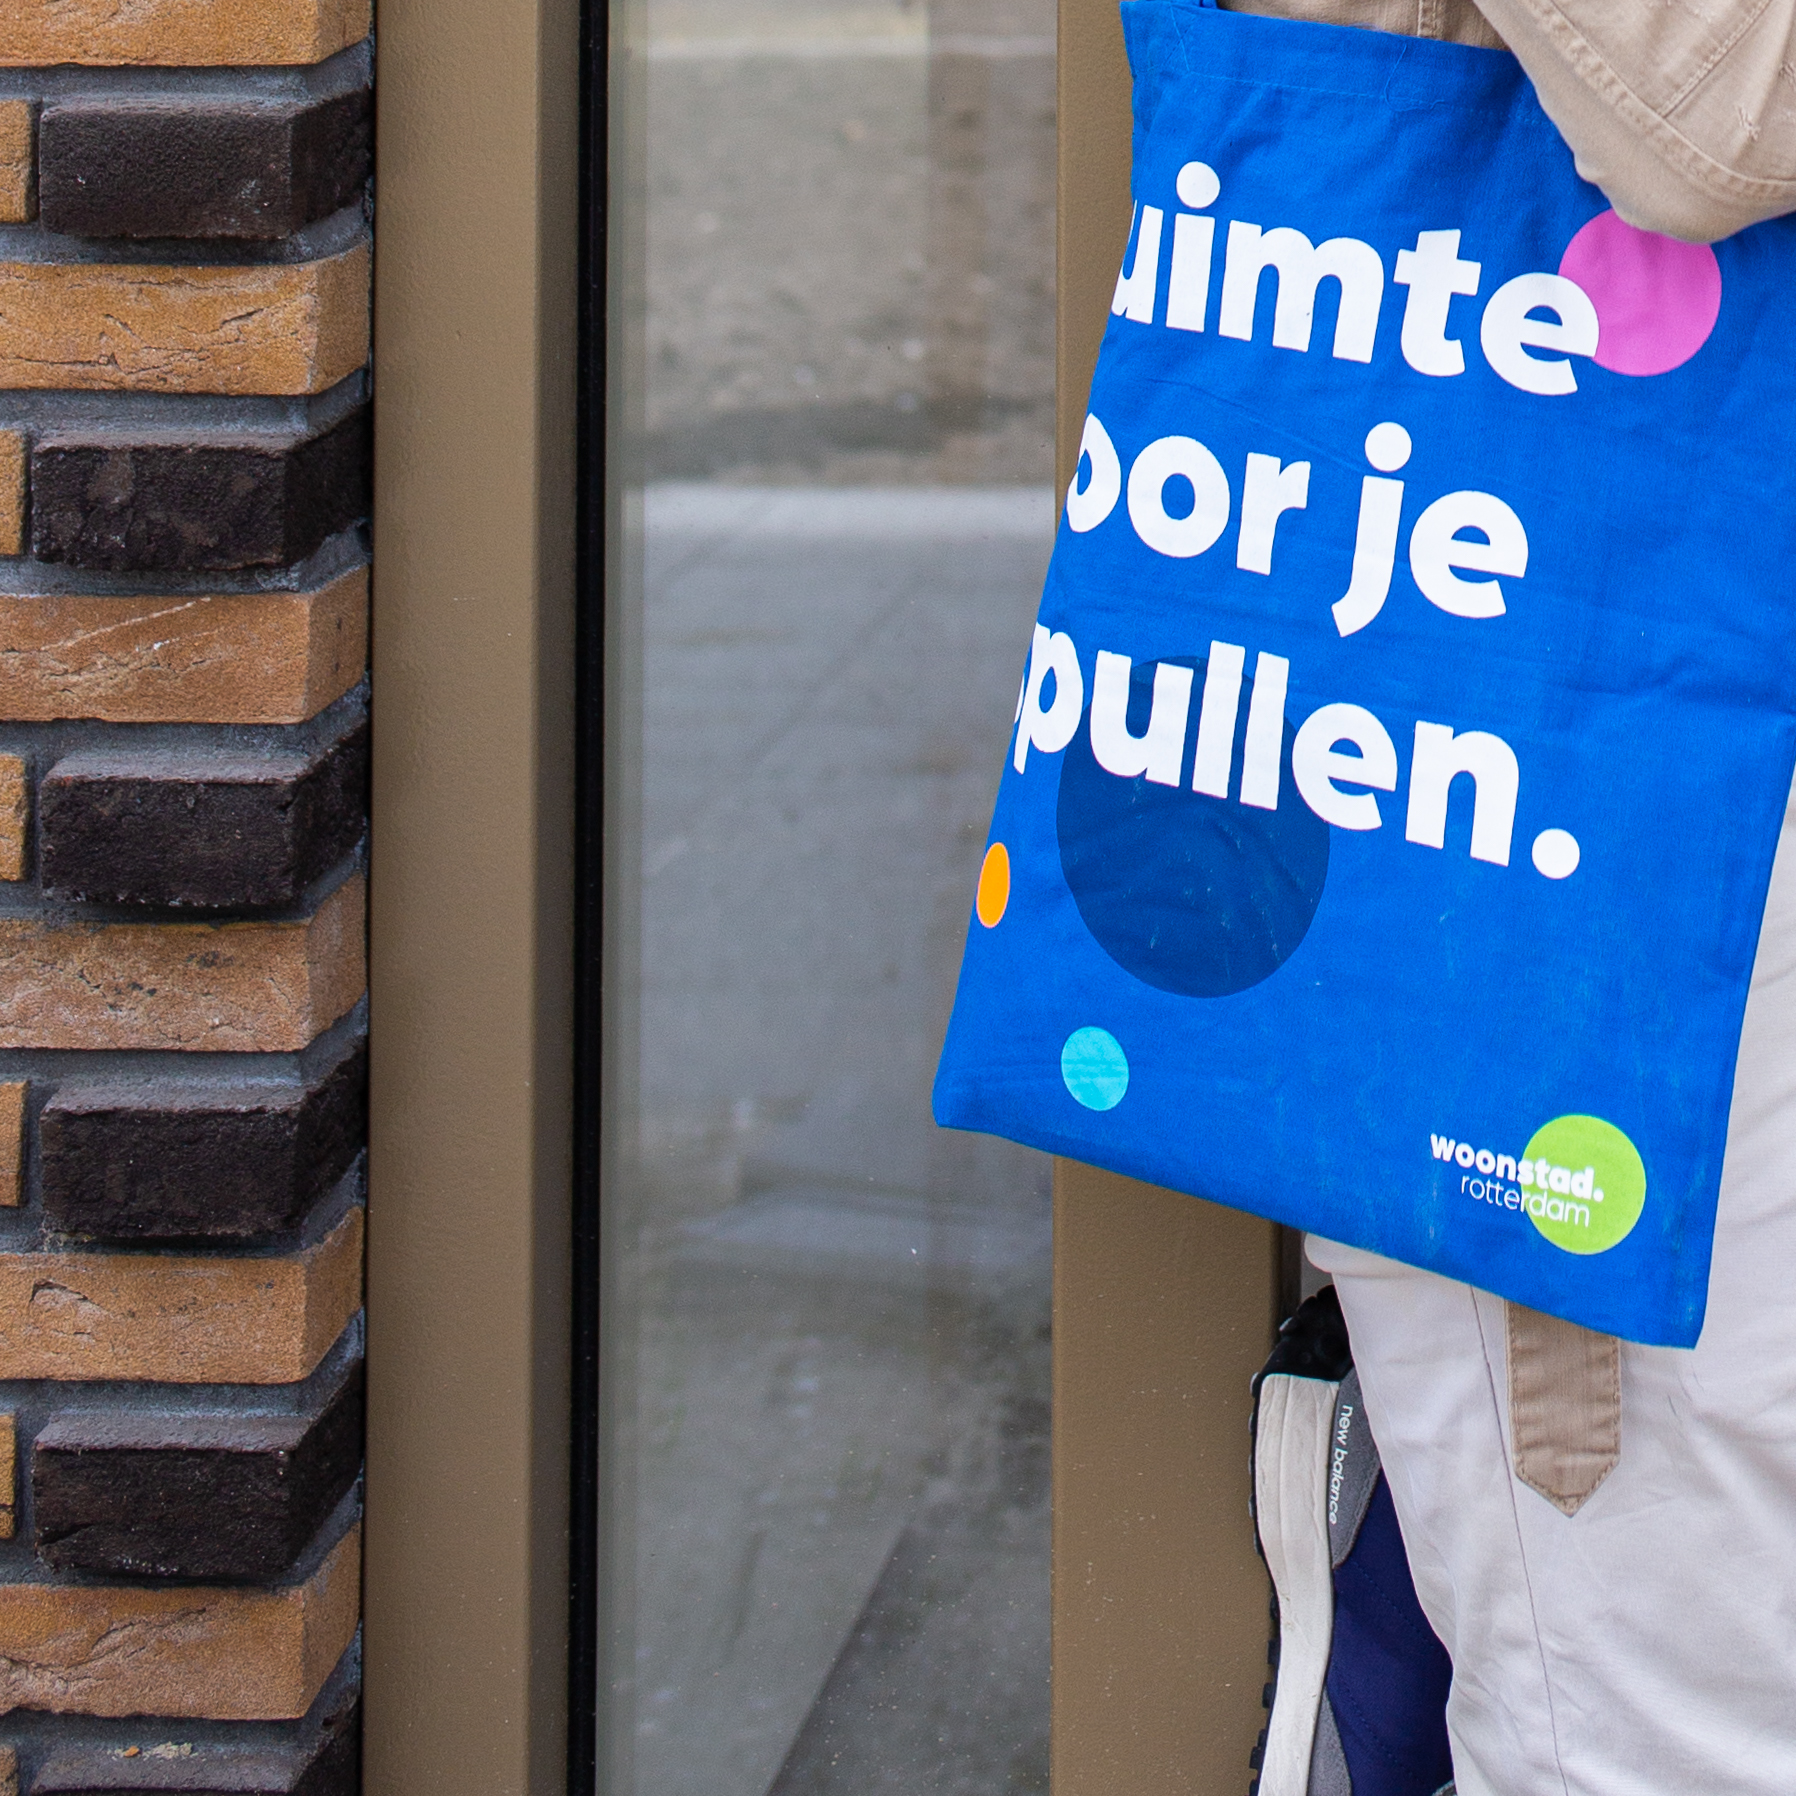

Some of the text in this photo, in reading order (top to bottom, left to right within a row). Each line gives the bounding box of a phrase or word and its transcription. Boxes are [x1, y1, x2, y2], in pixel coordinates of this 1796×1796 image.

[1332, 422, 1529, 637] je
[1014, 620, 1580, 879] pullen.
[1430, 1132, 1604, 1203] woonstad.
[1461, 1174, 1591, 1228] rotterdam
[1329, 1404, 1354, 1525] new balance
